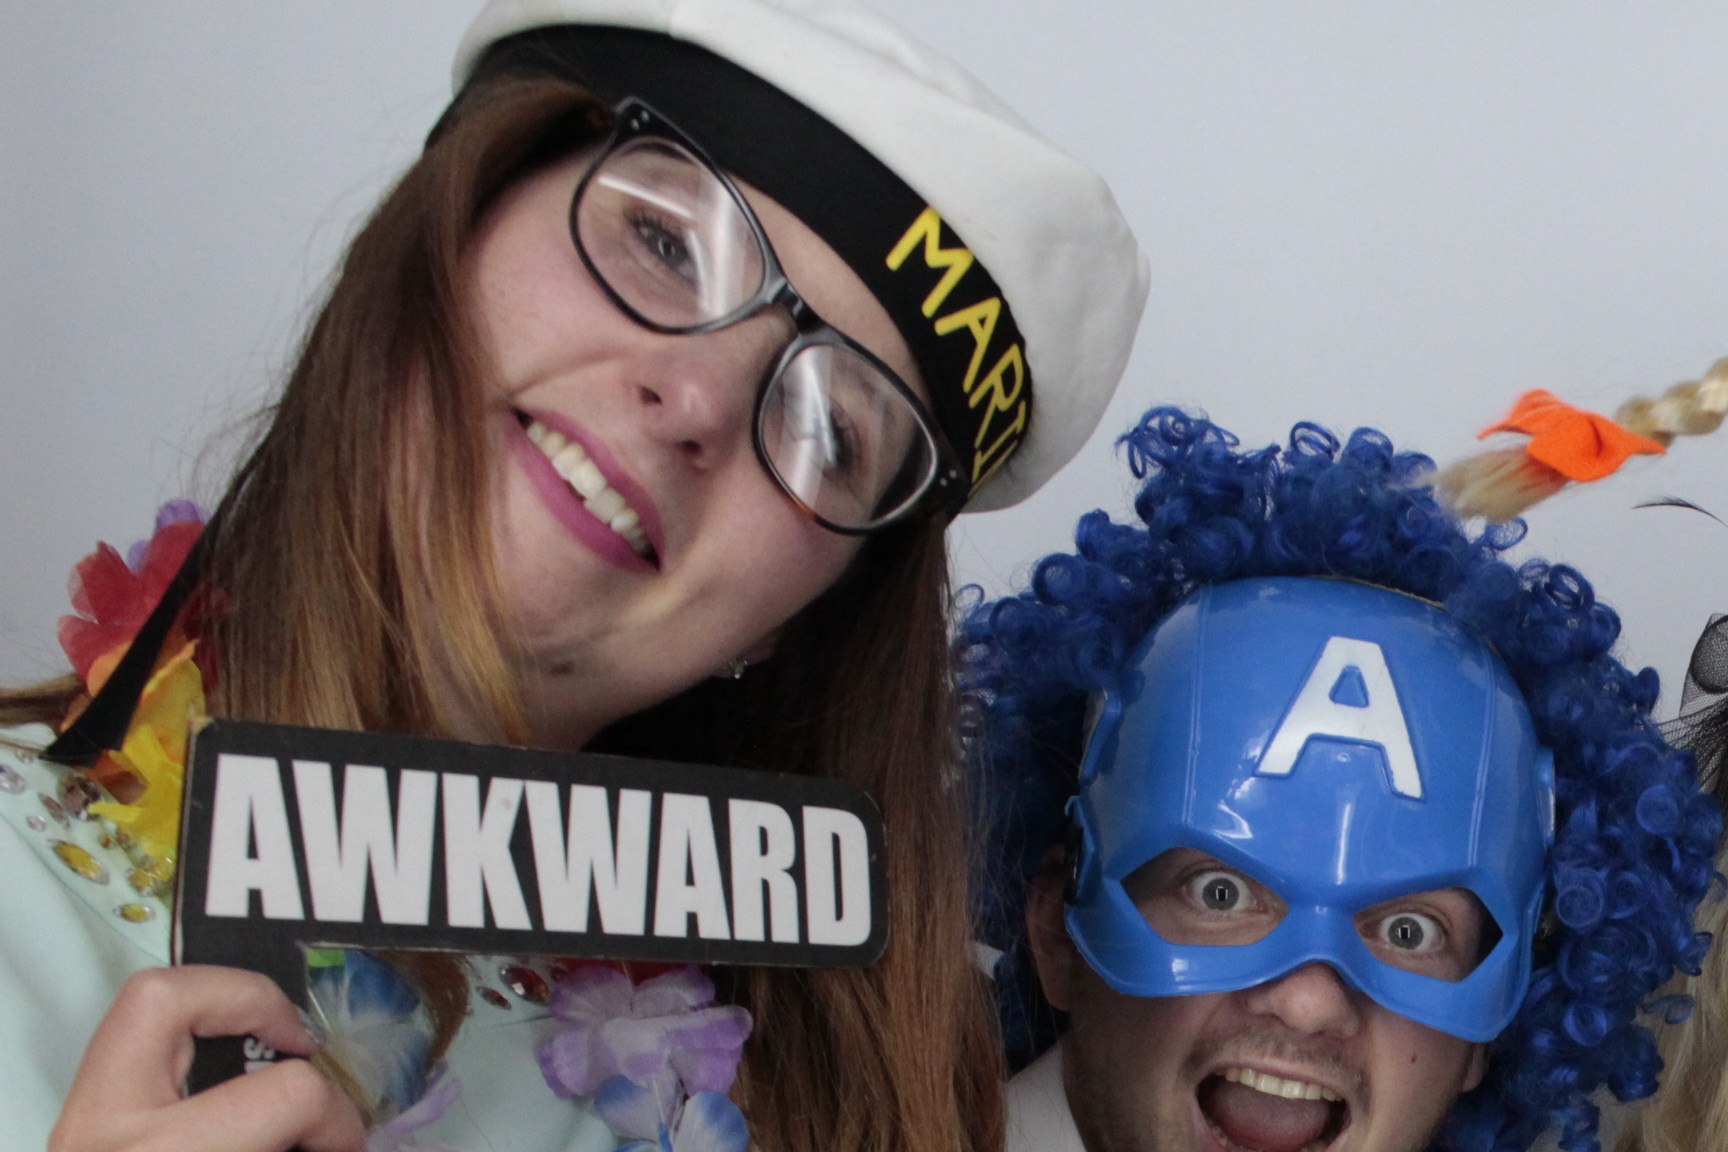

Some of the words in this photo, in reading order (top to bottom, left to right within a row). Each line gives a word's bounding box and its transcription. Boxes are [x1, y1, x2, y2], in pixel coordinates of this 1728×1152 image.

[886, 206, 1026, 500] MARI
[1256, 635, 1423, 799] A
[205, 753, 872, 948] AWKWARD
